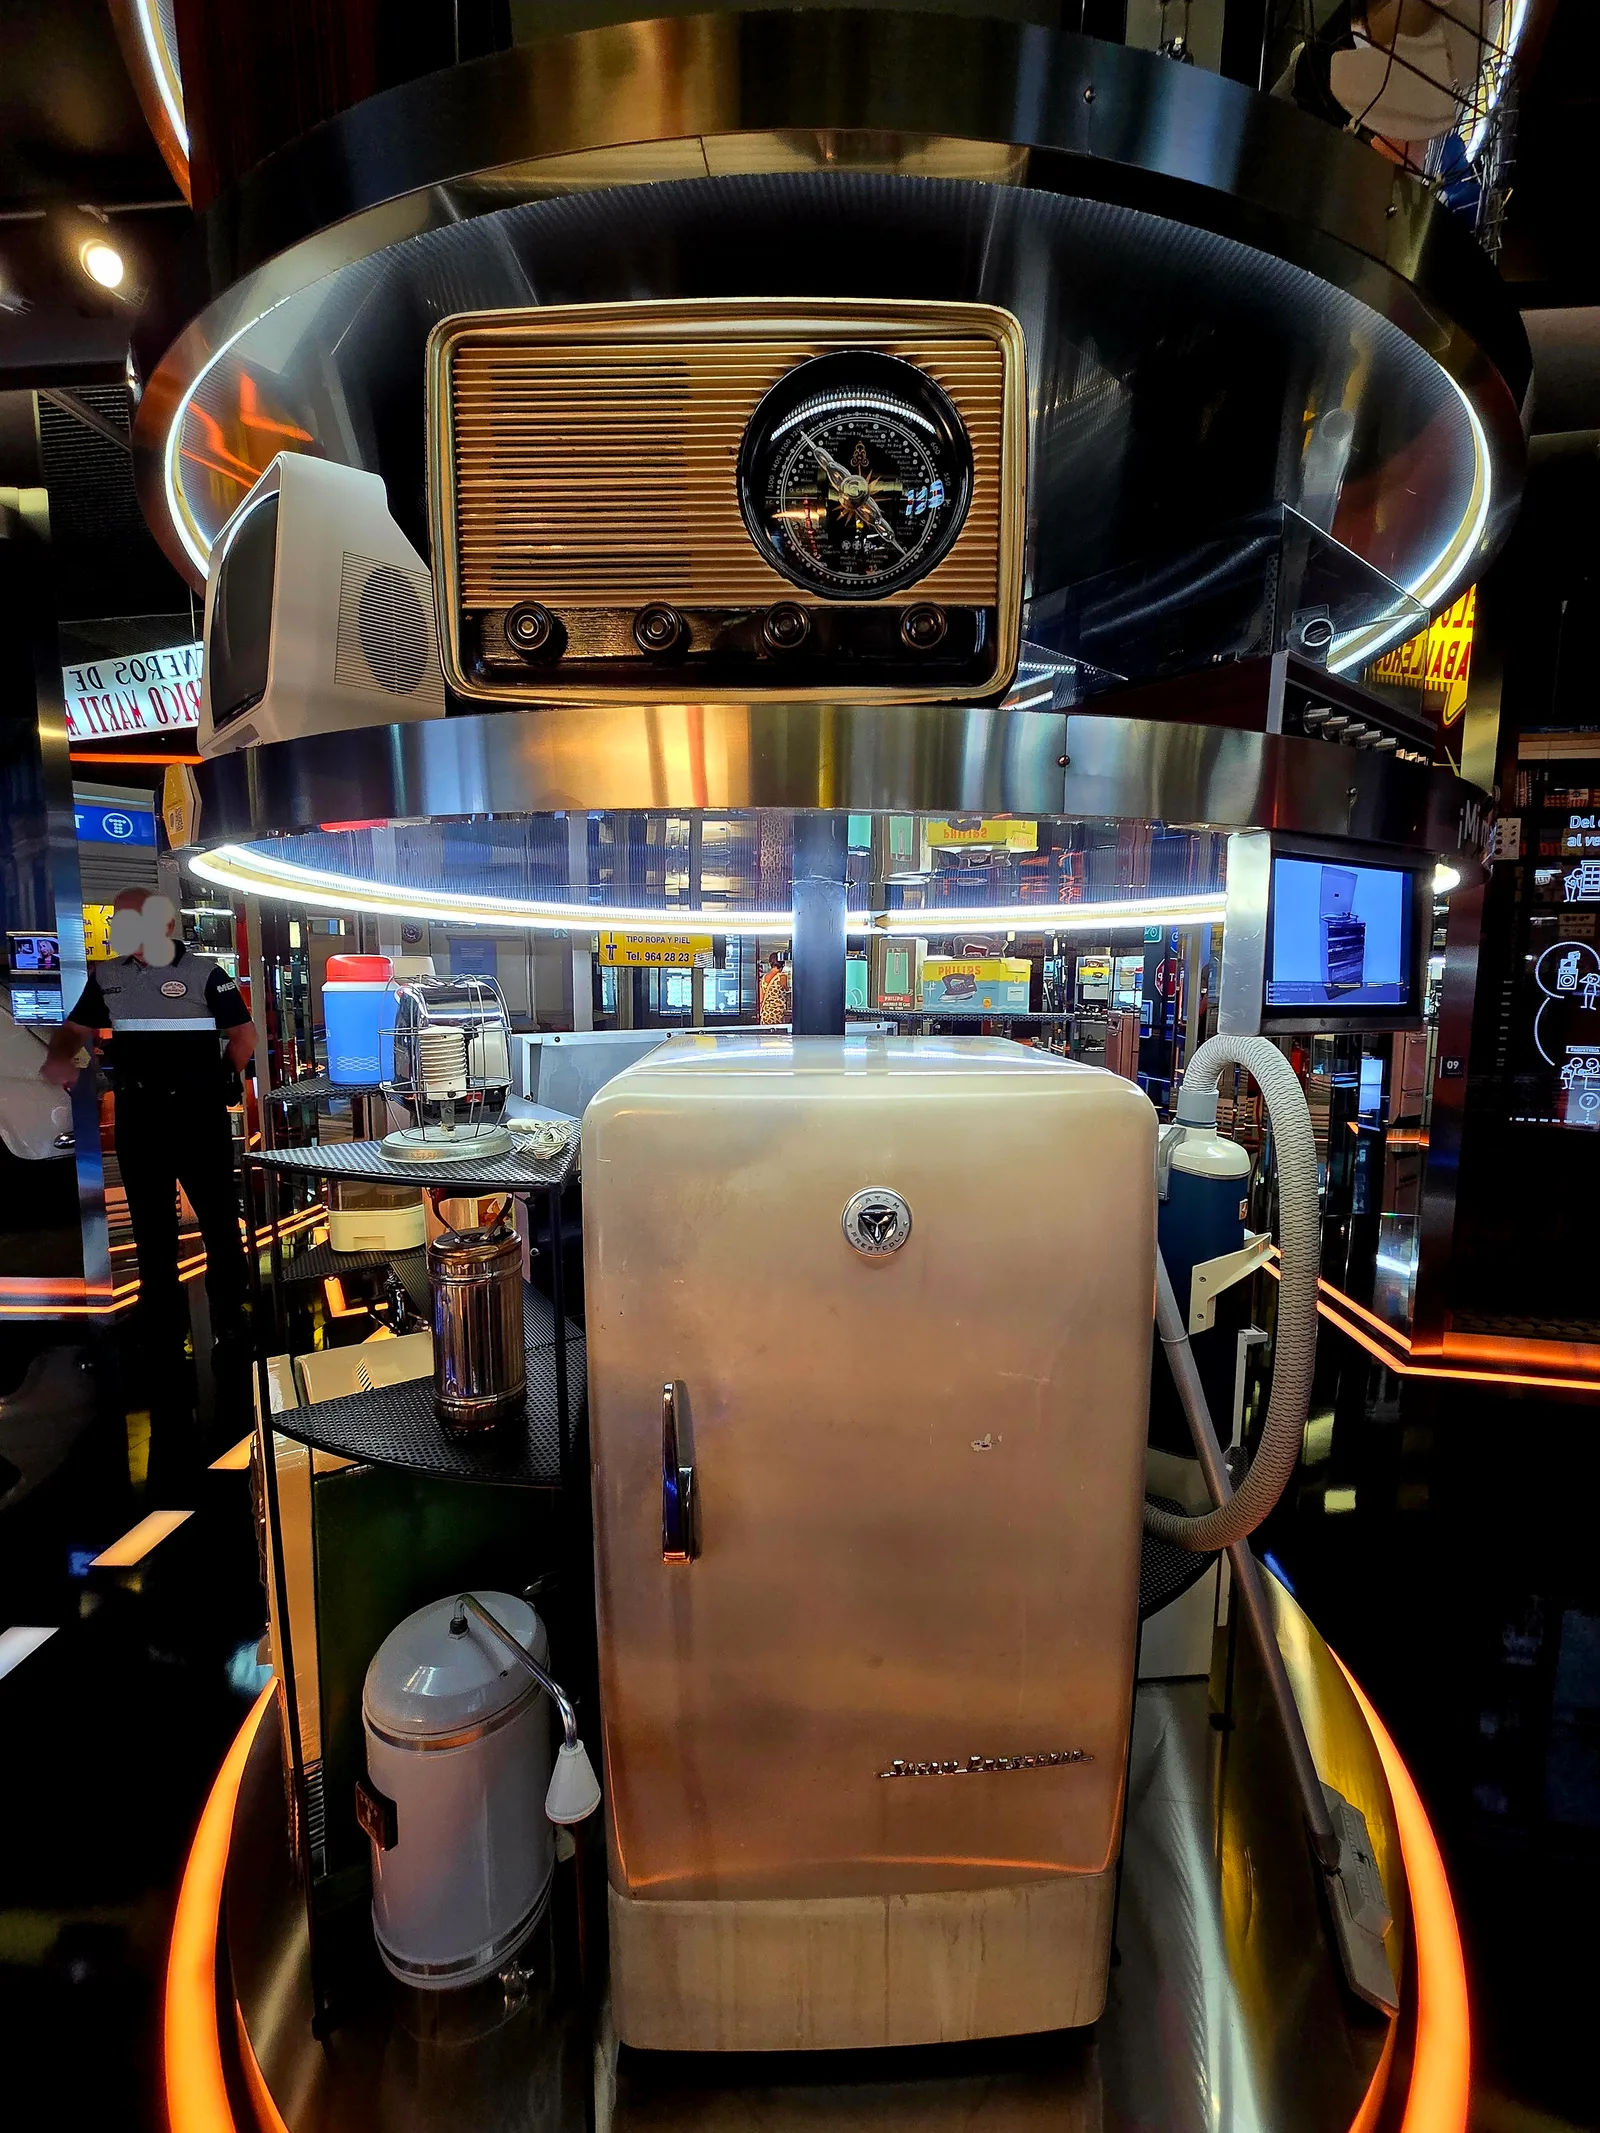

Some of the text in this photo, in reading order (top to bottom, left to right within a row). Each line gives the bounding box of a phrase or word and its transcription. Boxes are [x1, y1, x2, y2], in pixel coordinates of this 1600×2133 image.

[779, 438, 792, 454] 1300
[930, 442, 941, 455] 600
[771, 455, 782, 471] 1400
[767, 474, 775, 492] 1500
[943, 472, 951, 487] 550
[1570, 815, 1596, 829] Del
[1567, 834, 1582, 847] al
[626, 936, 642, 944] TIPO
[645, 936, 666, 944] ROPA
[626, 952, 642, 961] Tel.
[645, 952, 661, 961] 964
[664, 953, 676, 962] 28
[678, 953, 690, 962] 23
[938, 965, 982, 976] PHILIPS
[1446, 1061, 1459, 1069] 09
[1585, 1096, 1595, 1106] 7
[851, 1231, 904, 1252] PRESTCOLD
